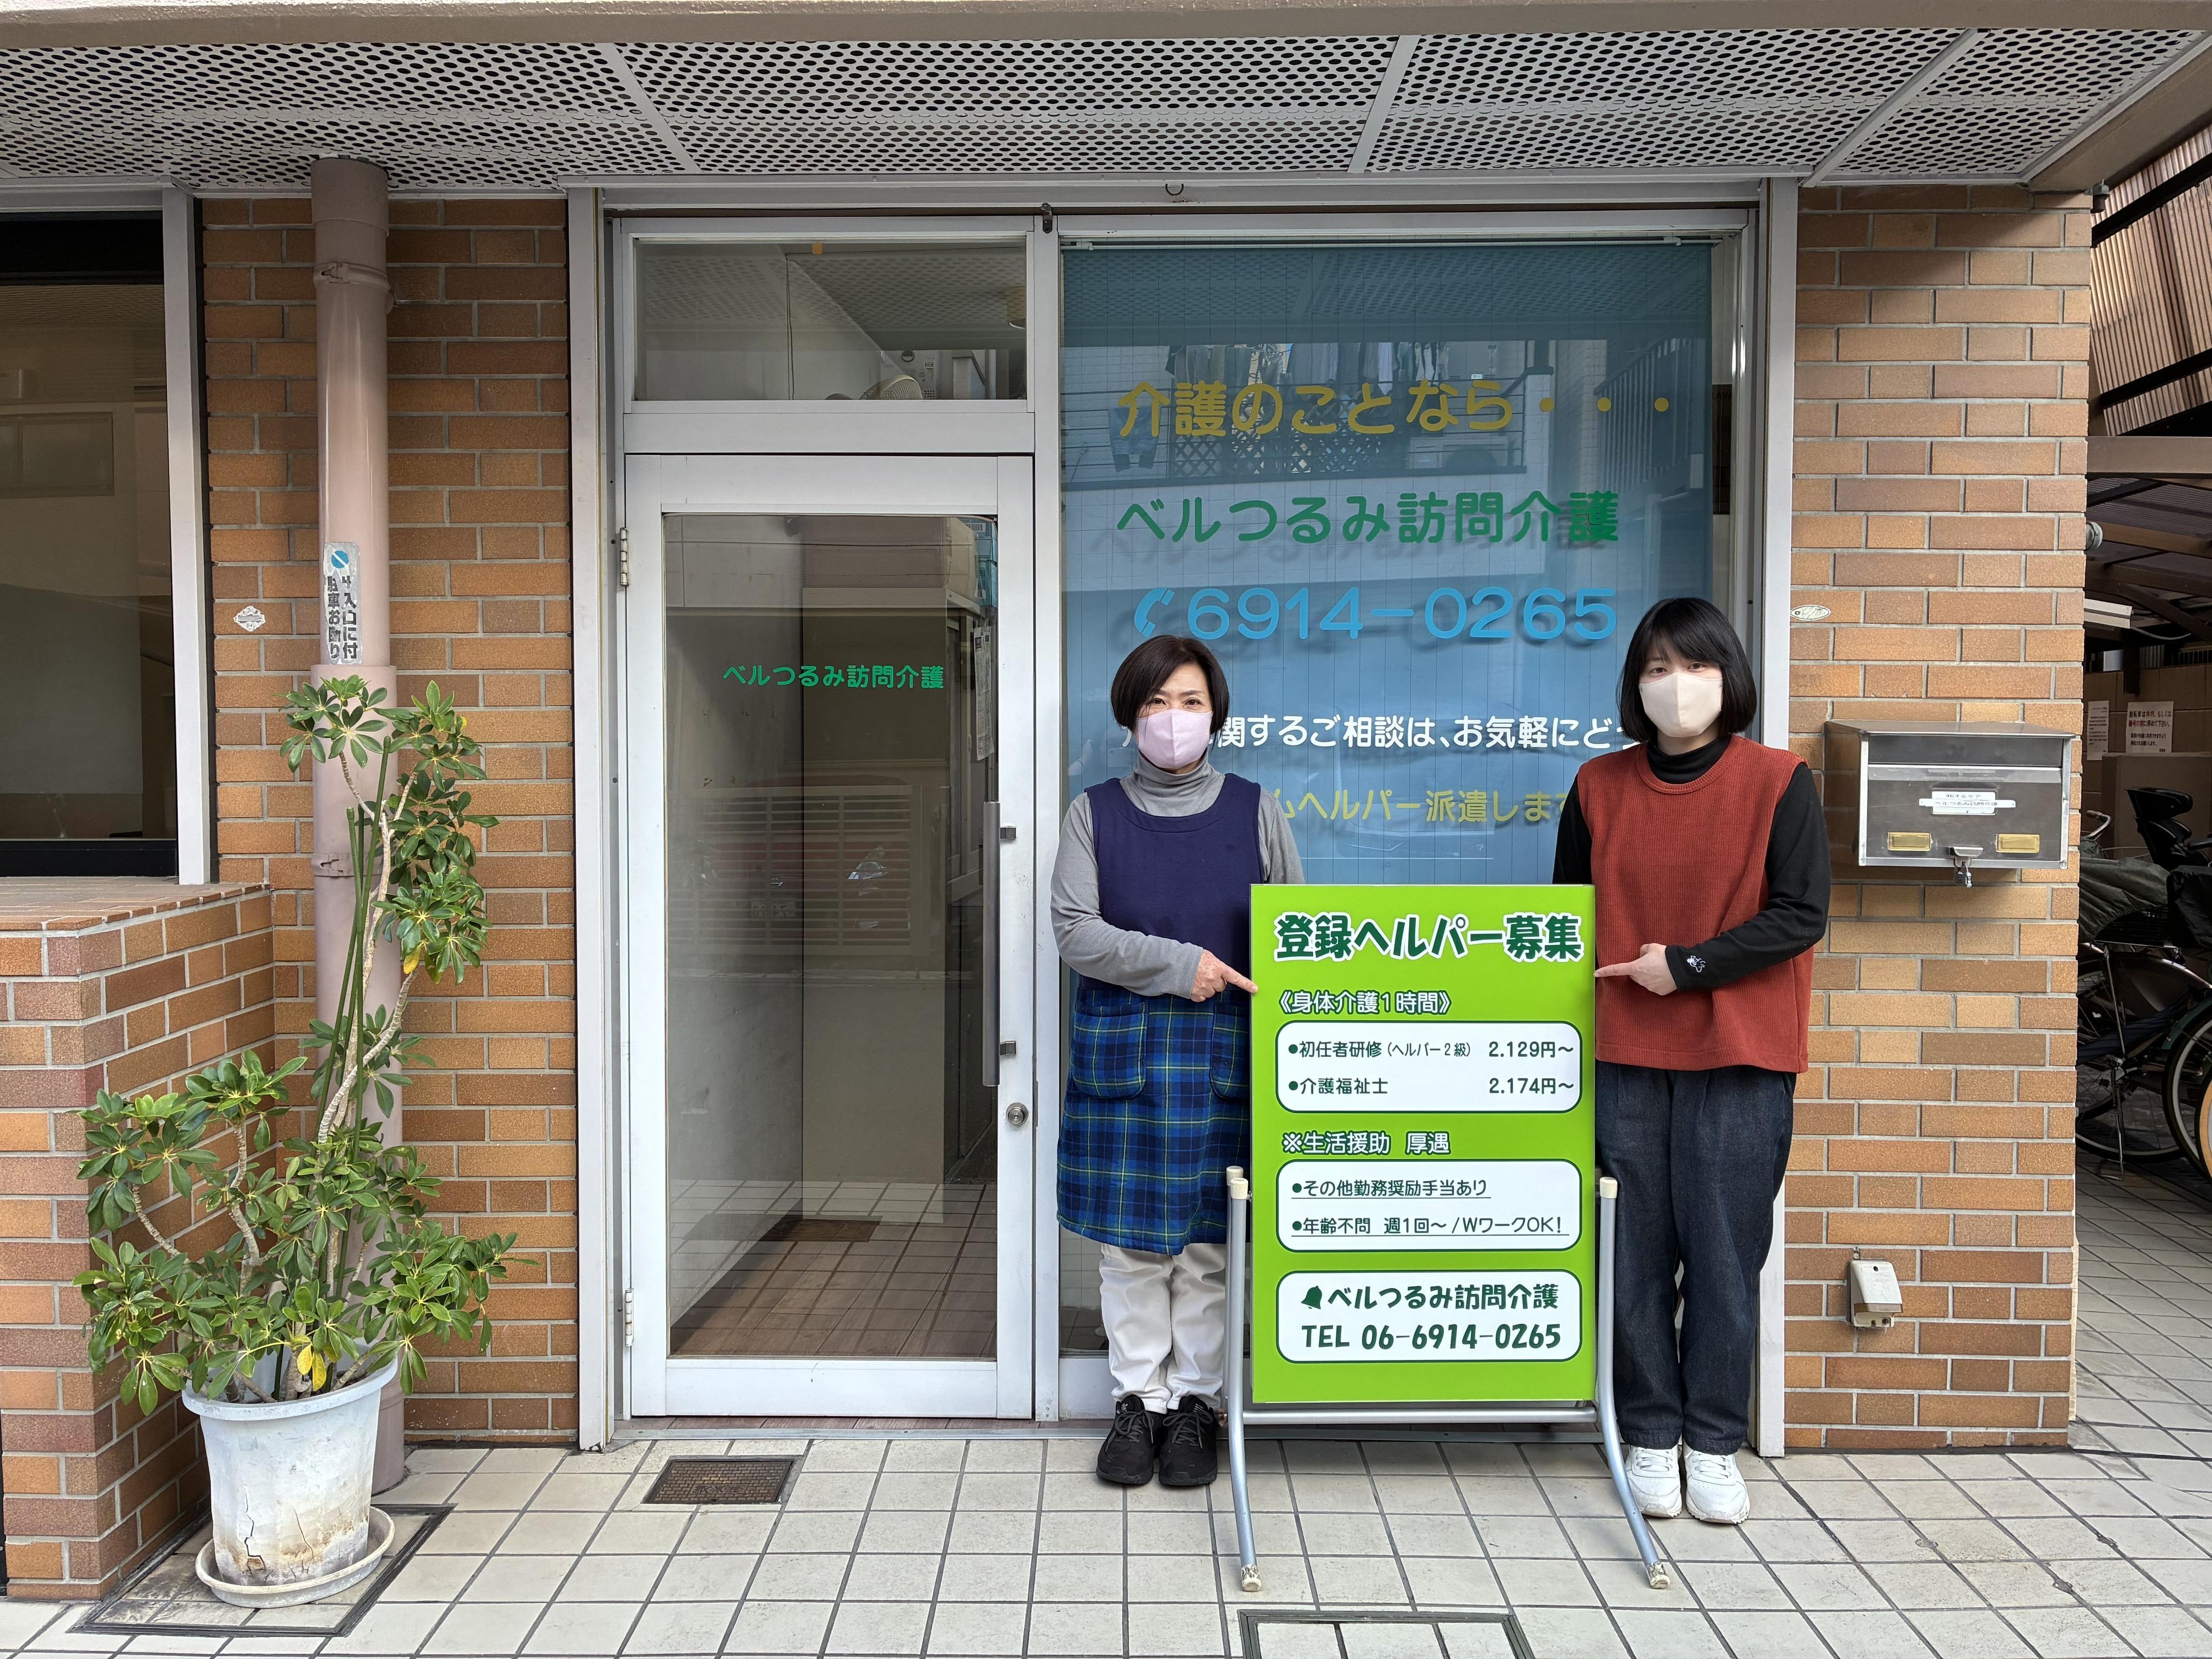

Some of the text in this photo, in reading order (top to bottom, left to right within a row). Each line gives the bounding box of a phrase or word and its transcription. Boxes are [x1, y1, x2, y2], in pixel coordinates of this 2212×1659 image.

[1117, 491, 1619, 544] ベルつるみ訪問介護
[1188, 586, 1617, 640] 6914-0265
[723, 665, 944, 689] ベルつるみ訪問介護
[1275, 913, 1583, 961] 登録ヘルパー募集
[1299, 1040, 1382, 1058] 初任者研修
[1300, 1078, 1389, 1095] 介護福祉士
[1405, 1131, 1451, 1155] 厚遇
[1302, 1179, 1487, 1197] その他勤務奨励手当あり
[1302, 1217, 1371, 1235] 年齢不問
[1328, 1284, 1559, 1310] ベルつるみ訪問介護
[1302, 1323, 1561, 1350] TEL 06-6914-0265
